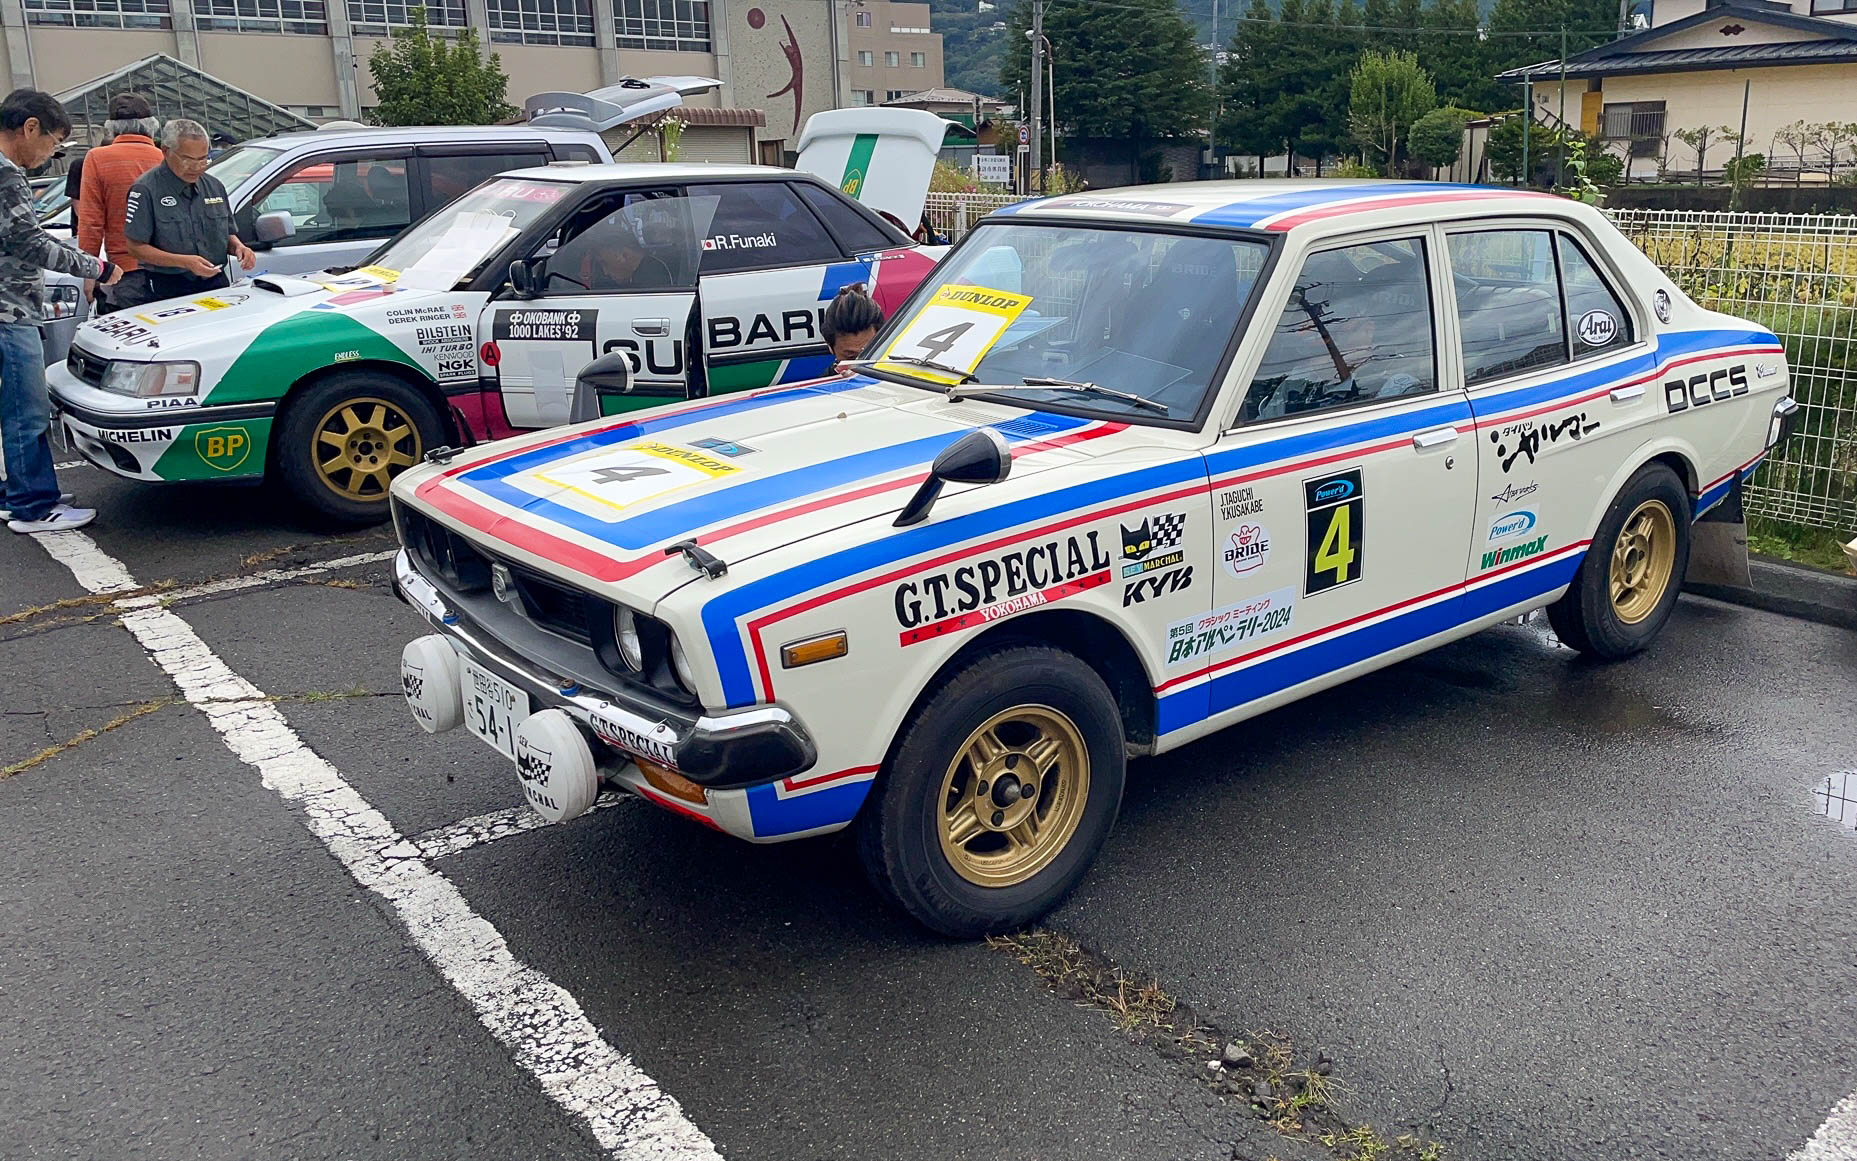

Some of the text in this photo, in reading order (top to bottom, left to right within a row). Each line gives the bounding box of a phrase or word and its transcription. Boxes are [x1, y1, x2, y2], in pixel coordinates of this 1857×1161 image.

[716, 233, 777, 250] R.Funaki
[948, 290, 1020, 310] DUNLOP
[386, 306, 446, 317] COLIN McRAE
[388, 313, 451, 325] DEREK RINGER
[523, 311, 568, 325] OKOBANK
[416, 324, 472, 340] BILSTEIN
[509, 325, 532, 338] 1000
[706, 308, 828, 349] BAR
[1580, 314, 1613, 337] Arai
[421, 342, 473, 354] IHI TURBO
[916, 321, 975, 361] 4
[433, 350, 475, 361] KENWOOD
[485, 344, 497, 360] A
[438, 358, 474, 371] NGK
[1664, 365, 1750, 414] DCCS
[146, 397, 200, 409] PIAA
[97, 428, 172, 444] MICHELIN
[207, 434, 245, 458] BP
[652, 446, 735, 471] DUNLOP
[590, 466, 673, 485] 4
[1220, 486, 1254, 508] J.TAGUCHI
[1220, 498, 1264, 521] Y.KUSAKABE
[1488, 517, 1526, 541] Power'd
[1224, 539, 1270, 562] BRIDE
[1314, 503, 1355, 584] 4
[1480, 534, 1549, 571] Winmax
[1122, 565, 1194, 608] KYB
[979, 591, 1048, 623] YOKOHAMA
[1169, 622, 1194, 640] 第5回
[475, 694, 521, 756] 54-1
